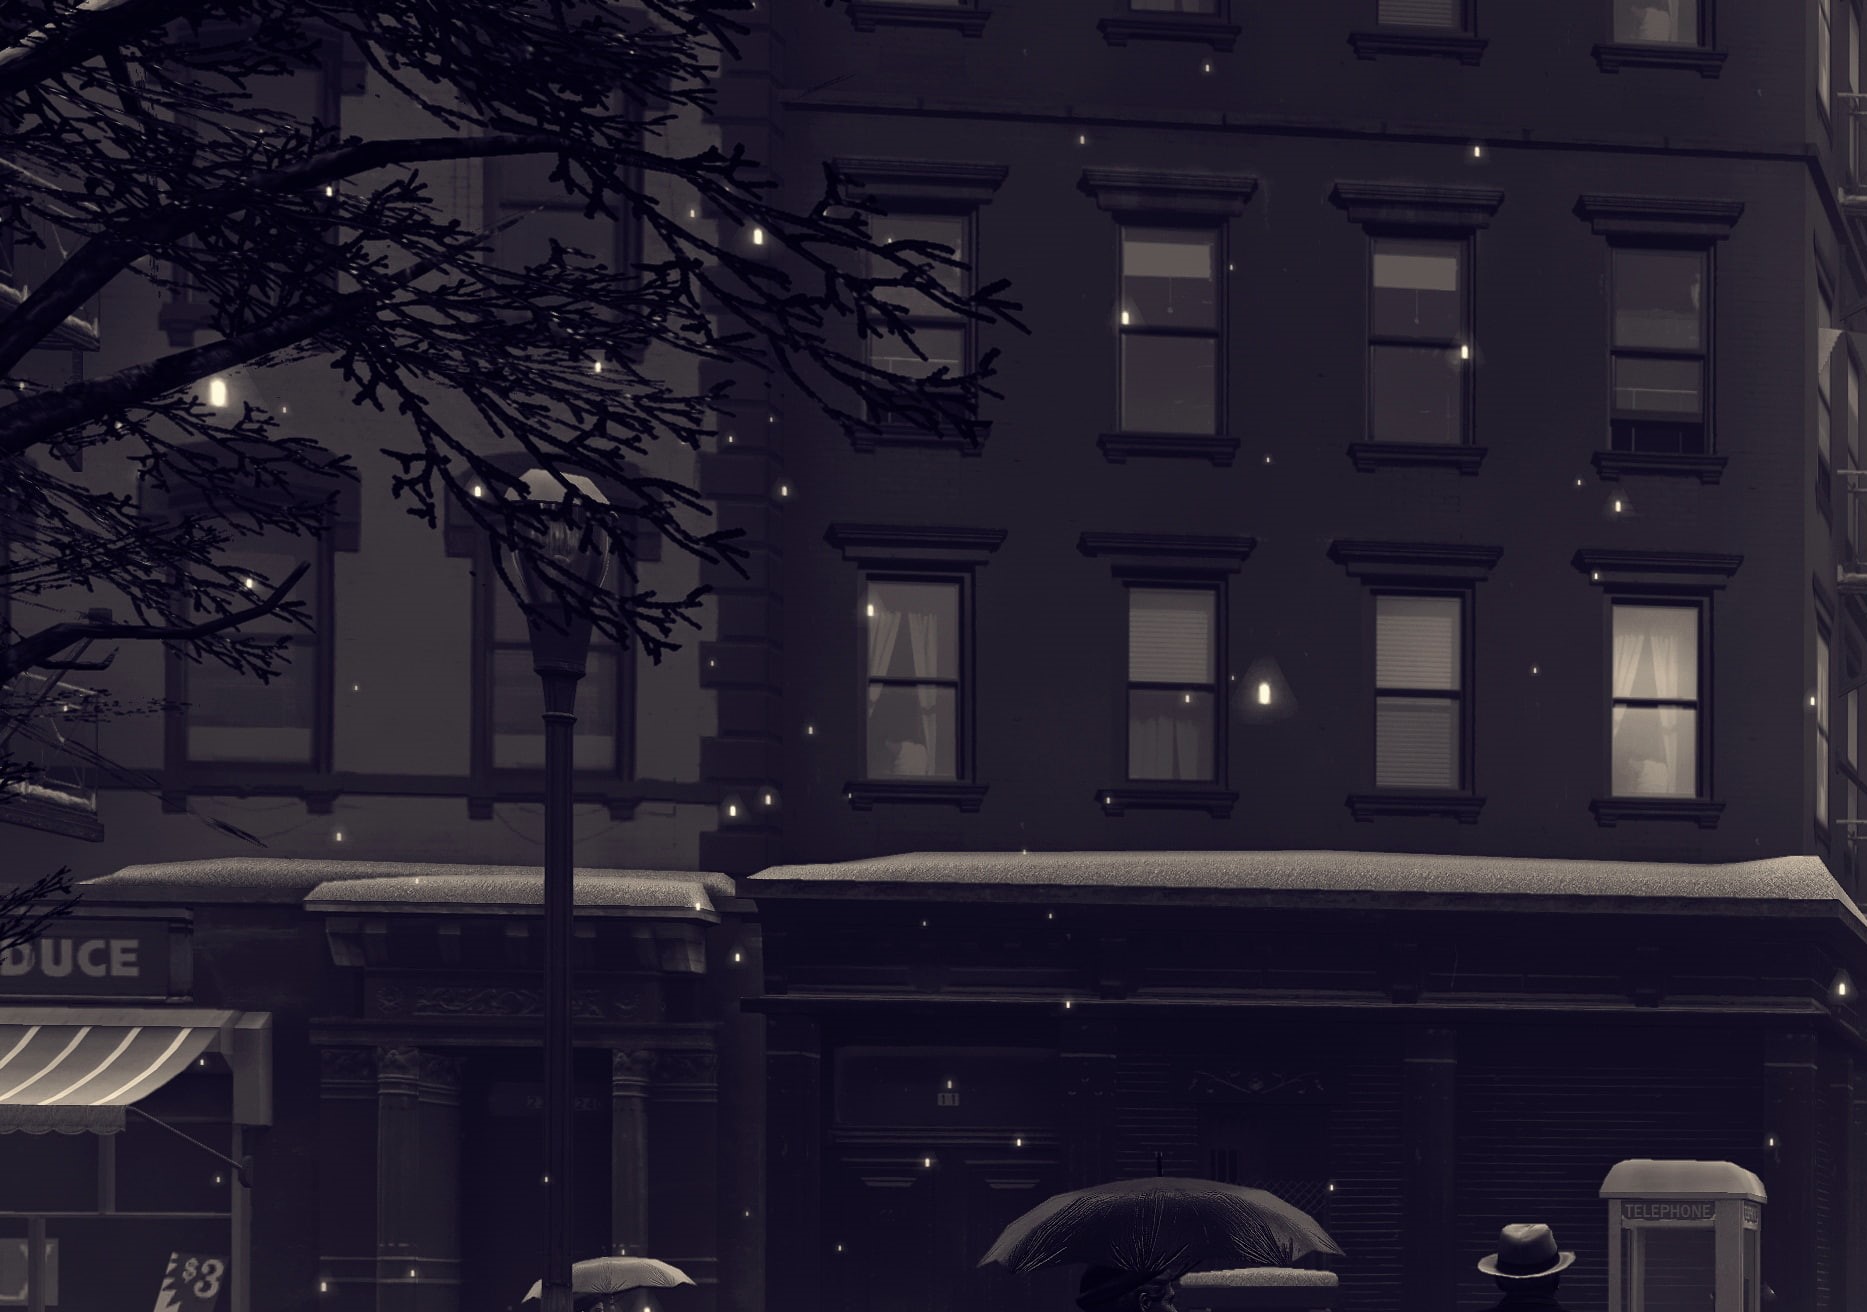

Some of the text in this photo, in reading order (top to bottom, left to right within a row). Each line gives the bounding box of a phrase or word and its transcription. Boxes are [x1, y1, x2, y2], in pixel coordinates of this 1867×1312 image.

[0, 936, 140, 978] DUCE
[1624, 1203, 1712, 1218] TELEPHONE
[181, 1256, 225, 1300] $3
